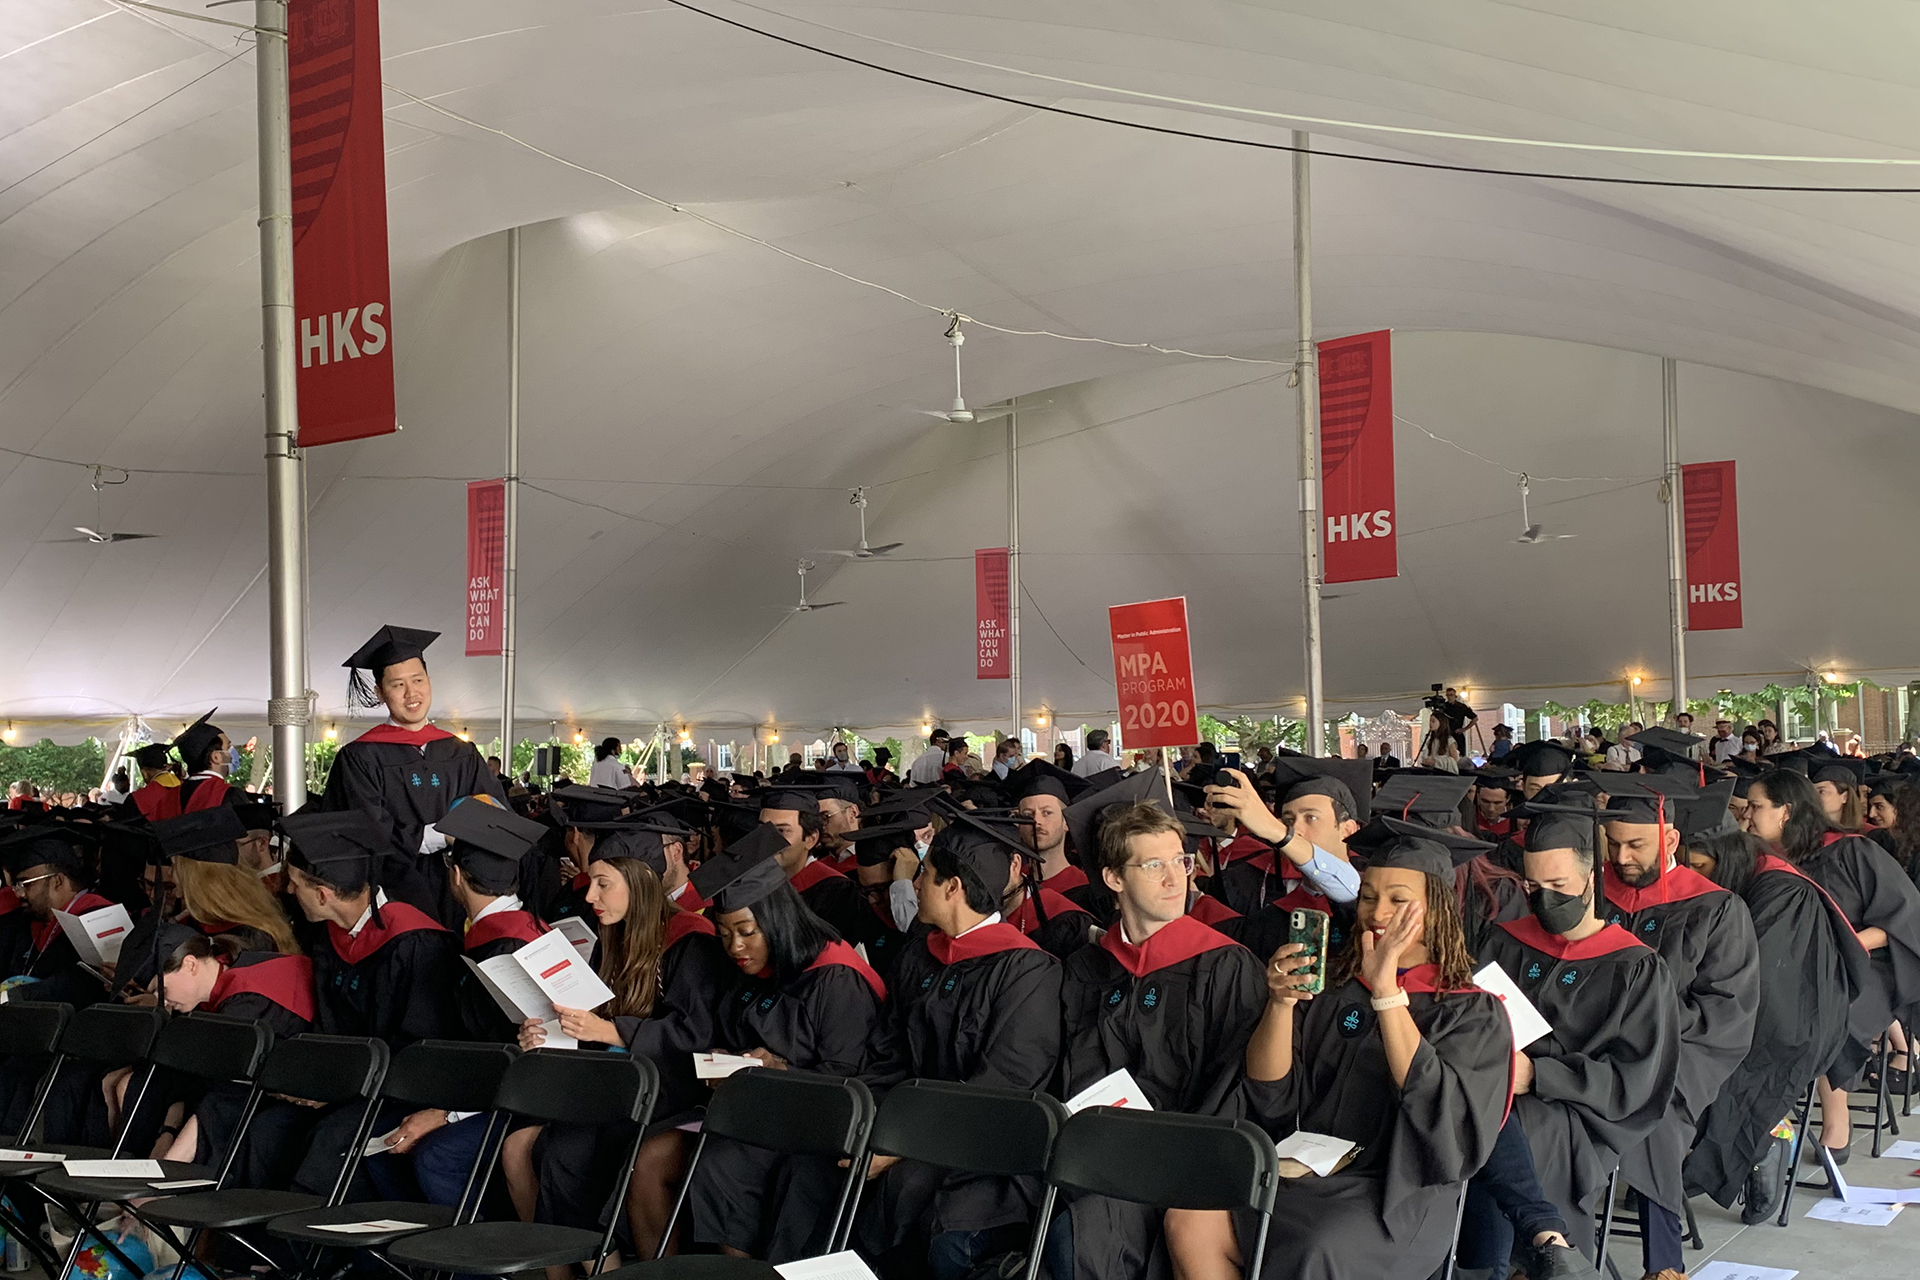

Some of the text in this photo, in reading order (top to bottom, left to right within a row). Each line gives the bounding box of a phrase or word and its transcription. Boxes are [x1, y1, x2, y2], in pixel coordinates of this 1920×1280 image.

[301, 302, 387, 368] HKS
[1327, 510, 1392, 543] HKS
[470, 576, 490, 588] ASK
[470, 588, 499, 601] WHAT
[1690, 582, 1738, 603] HKS
[470, 602, 490, 615] YOU
[470, 615, 490, 628] CAN
[979, 619, 997, 629] ASK
[470, 629, 484, 640] DO
[979, 629, 1006, 639] WHAT
[979, 639, 998, 648] YOU
[980, 648, 998, 658] CAN
[980, 658, 994, 668] DO
[1120, 651, 1168, 678] MPA
[1122, 677, 1186, 694] PROGRAM
[1125, 700, 1190, 730] 2020
